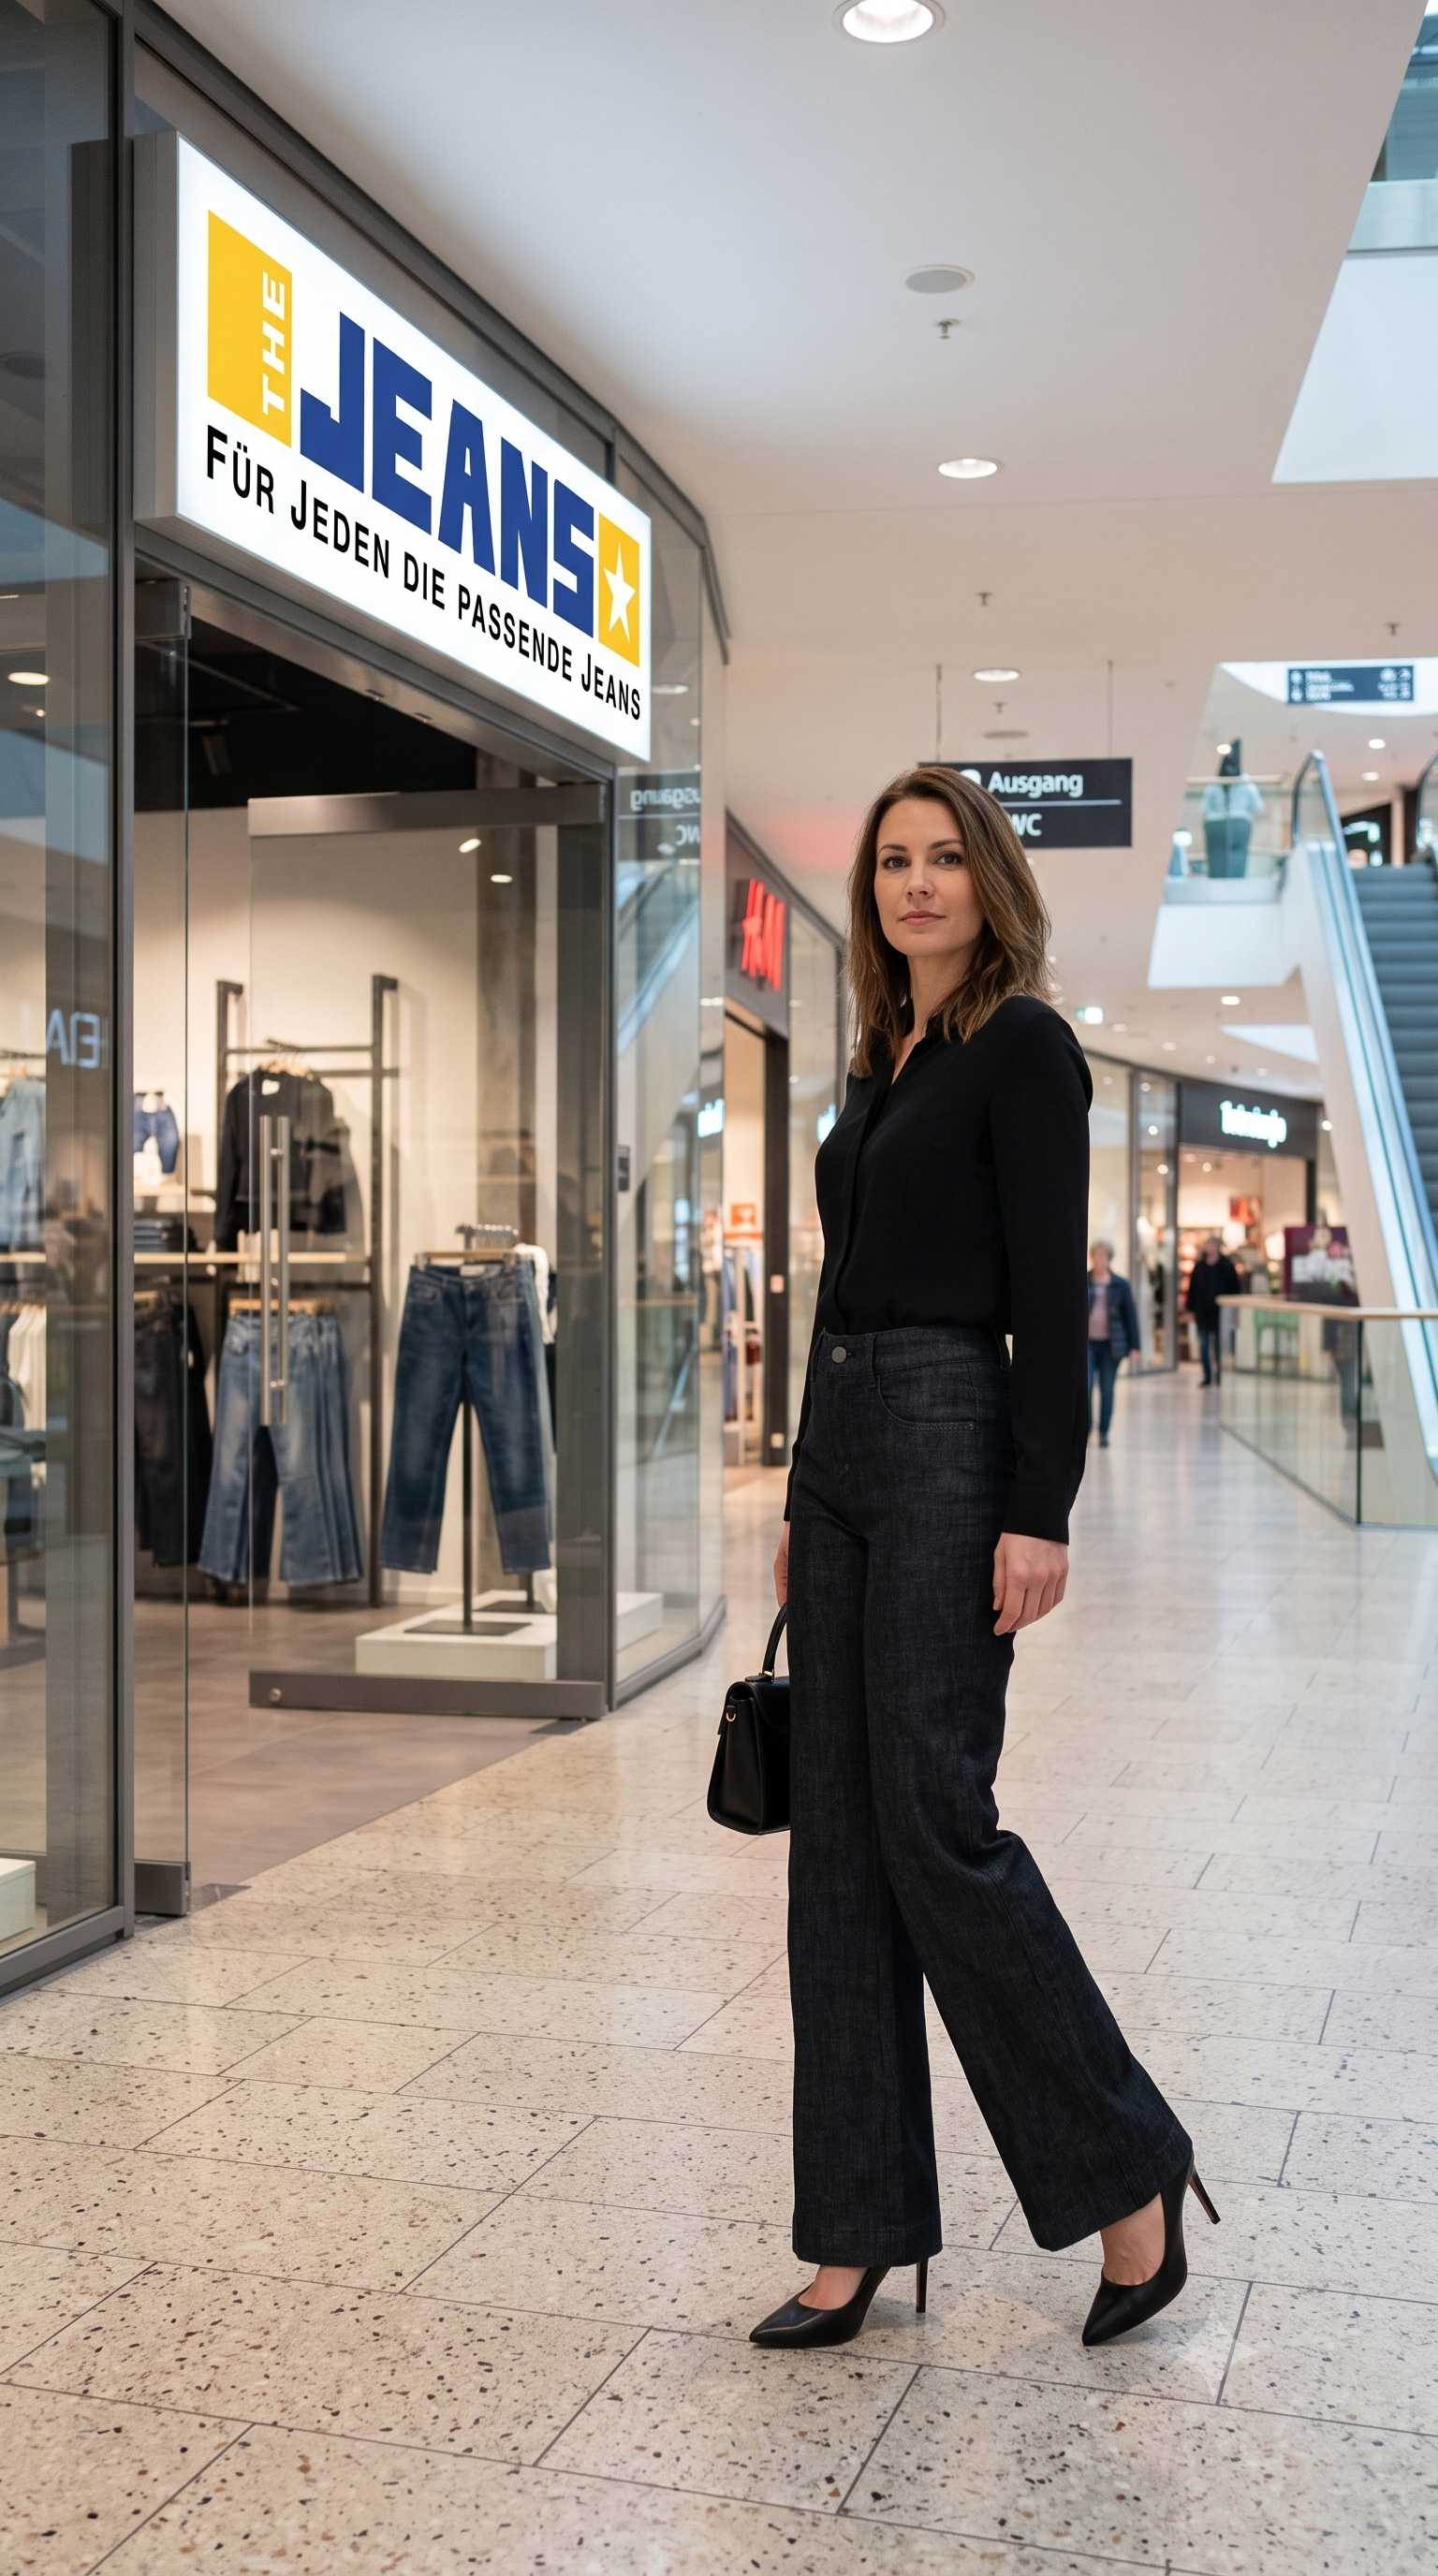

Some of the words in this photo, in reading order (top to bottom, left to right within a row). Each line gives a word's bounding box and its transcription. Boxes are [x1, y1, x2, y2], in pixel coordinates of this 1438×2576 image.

[262, 271, 286, 416] THE
[207, 424, 274, 515] FÜR
[404, 551, 446, 610] DIE
[458, 583, 572, 682] PASSENDE
[580, 652, 640, 721] JEANS
[300, 312, 594, 637] JEANS
[988, 771, 1084, 799] Ausgang
